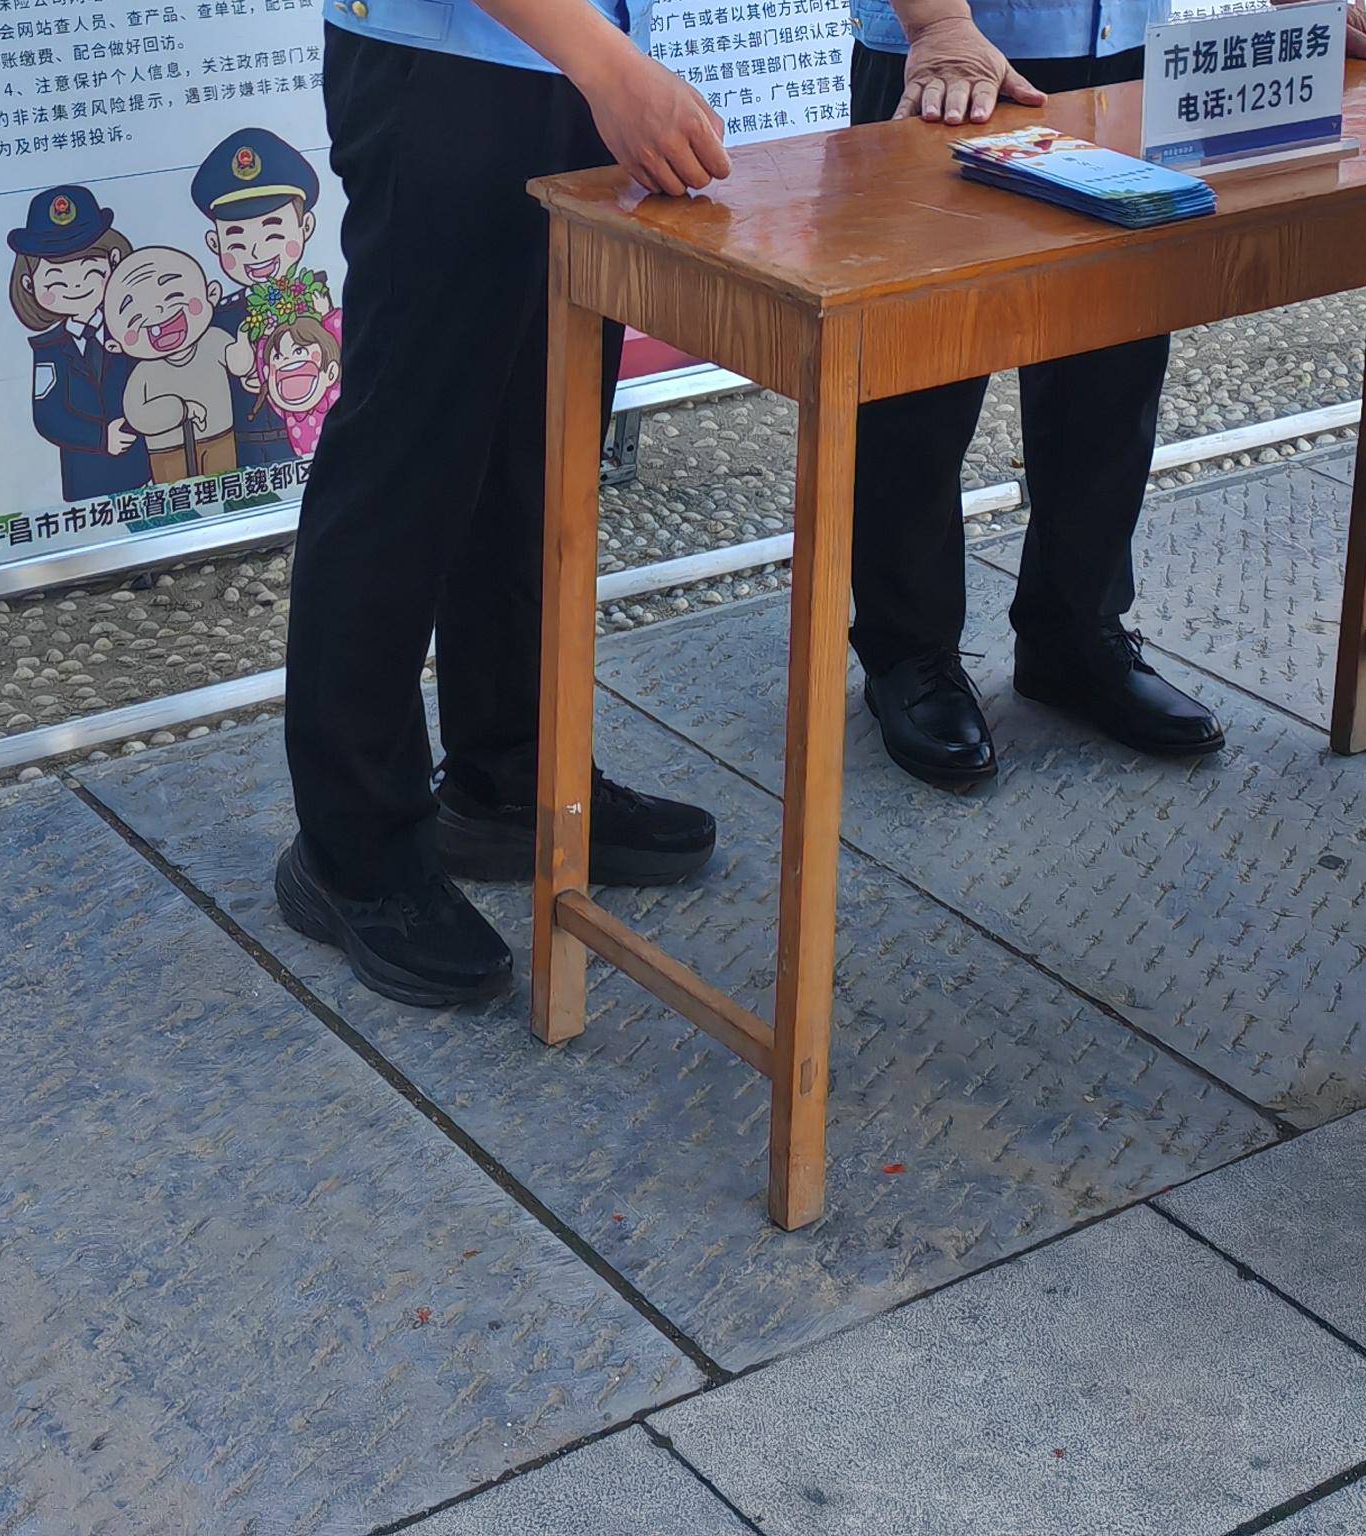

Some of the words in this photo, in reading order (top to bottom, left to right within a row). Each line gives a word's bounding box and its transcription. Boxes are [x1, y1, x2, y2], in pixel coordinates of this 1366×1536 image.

[3, 45, 321, 97] 4、注意保护个人信息，关注政府部门发
[1163, 23, 1332, 80] 市场监管服务
[1177, 75, 1314, 123] 电话:12315
